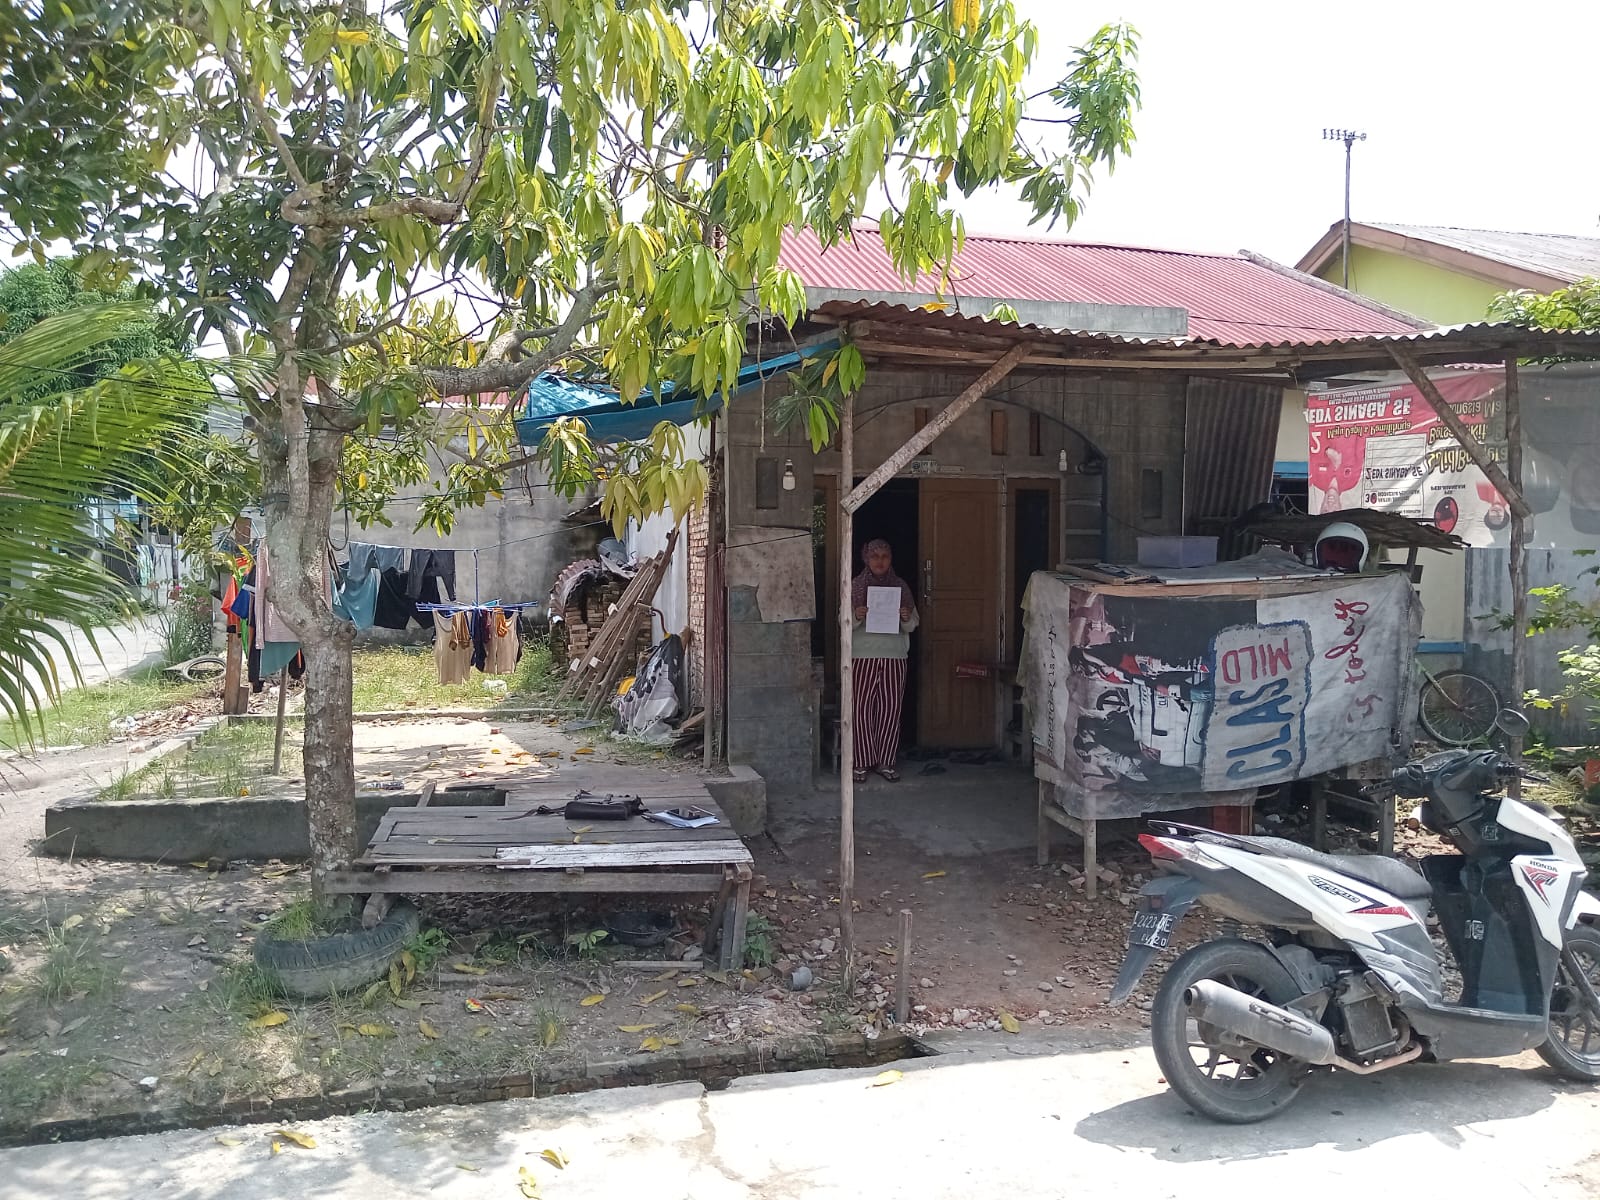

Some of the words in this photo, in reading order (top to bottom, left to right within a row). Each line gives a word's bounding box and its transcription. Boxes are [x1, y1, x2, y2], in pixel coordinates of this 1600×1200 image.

[1324, 598, 1369, 685] today
[1225, 677, 1295, 781] CLAS
[1529, 860, 1558, 872] HONDA
